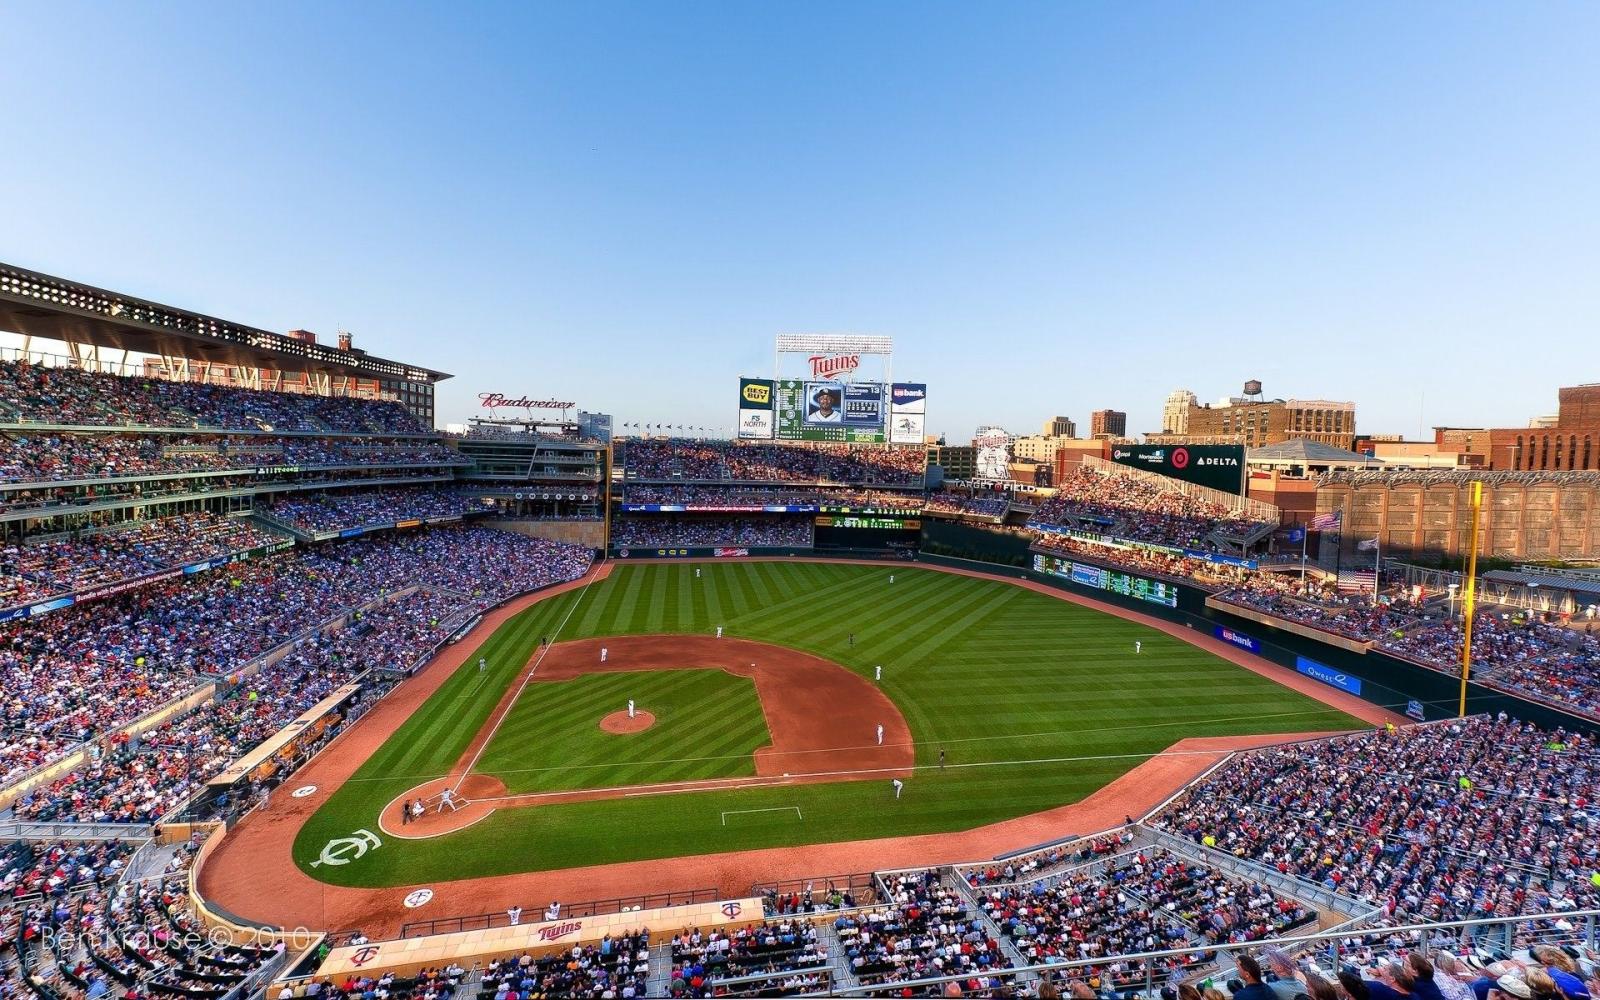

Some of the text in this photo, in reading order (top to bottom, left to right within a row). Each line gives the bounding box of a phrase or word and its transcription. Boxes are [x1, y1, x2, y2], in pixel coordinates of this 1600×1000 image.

[808, 354, 860, 379] Twins
[747, 387, 768, 395] BEST
[478, 393, 576, 409] Budweiser
[1206, 457, 1238, 466] DELTA
[955, 479, 1036, 493] TARGET FIELD
[1307, 667, 1333, 682] Qwest
[538, 921, 582, 941] Twins
